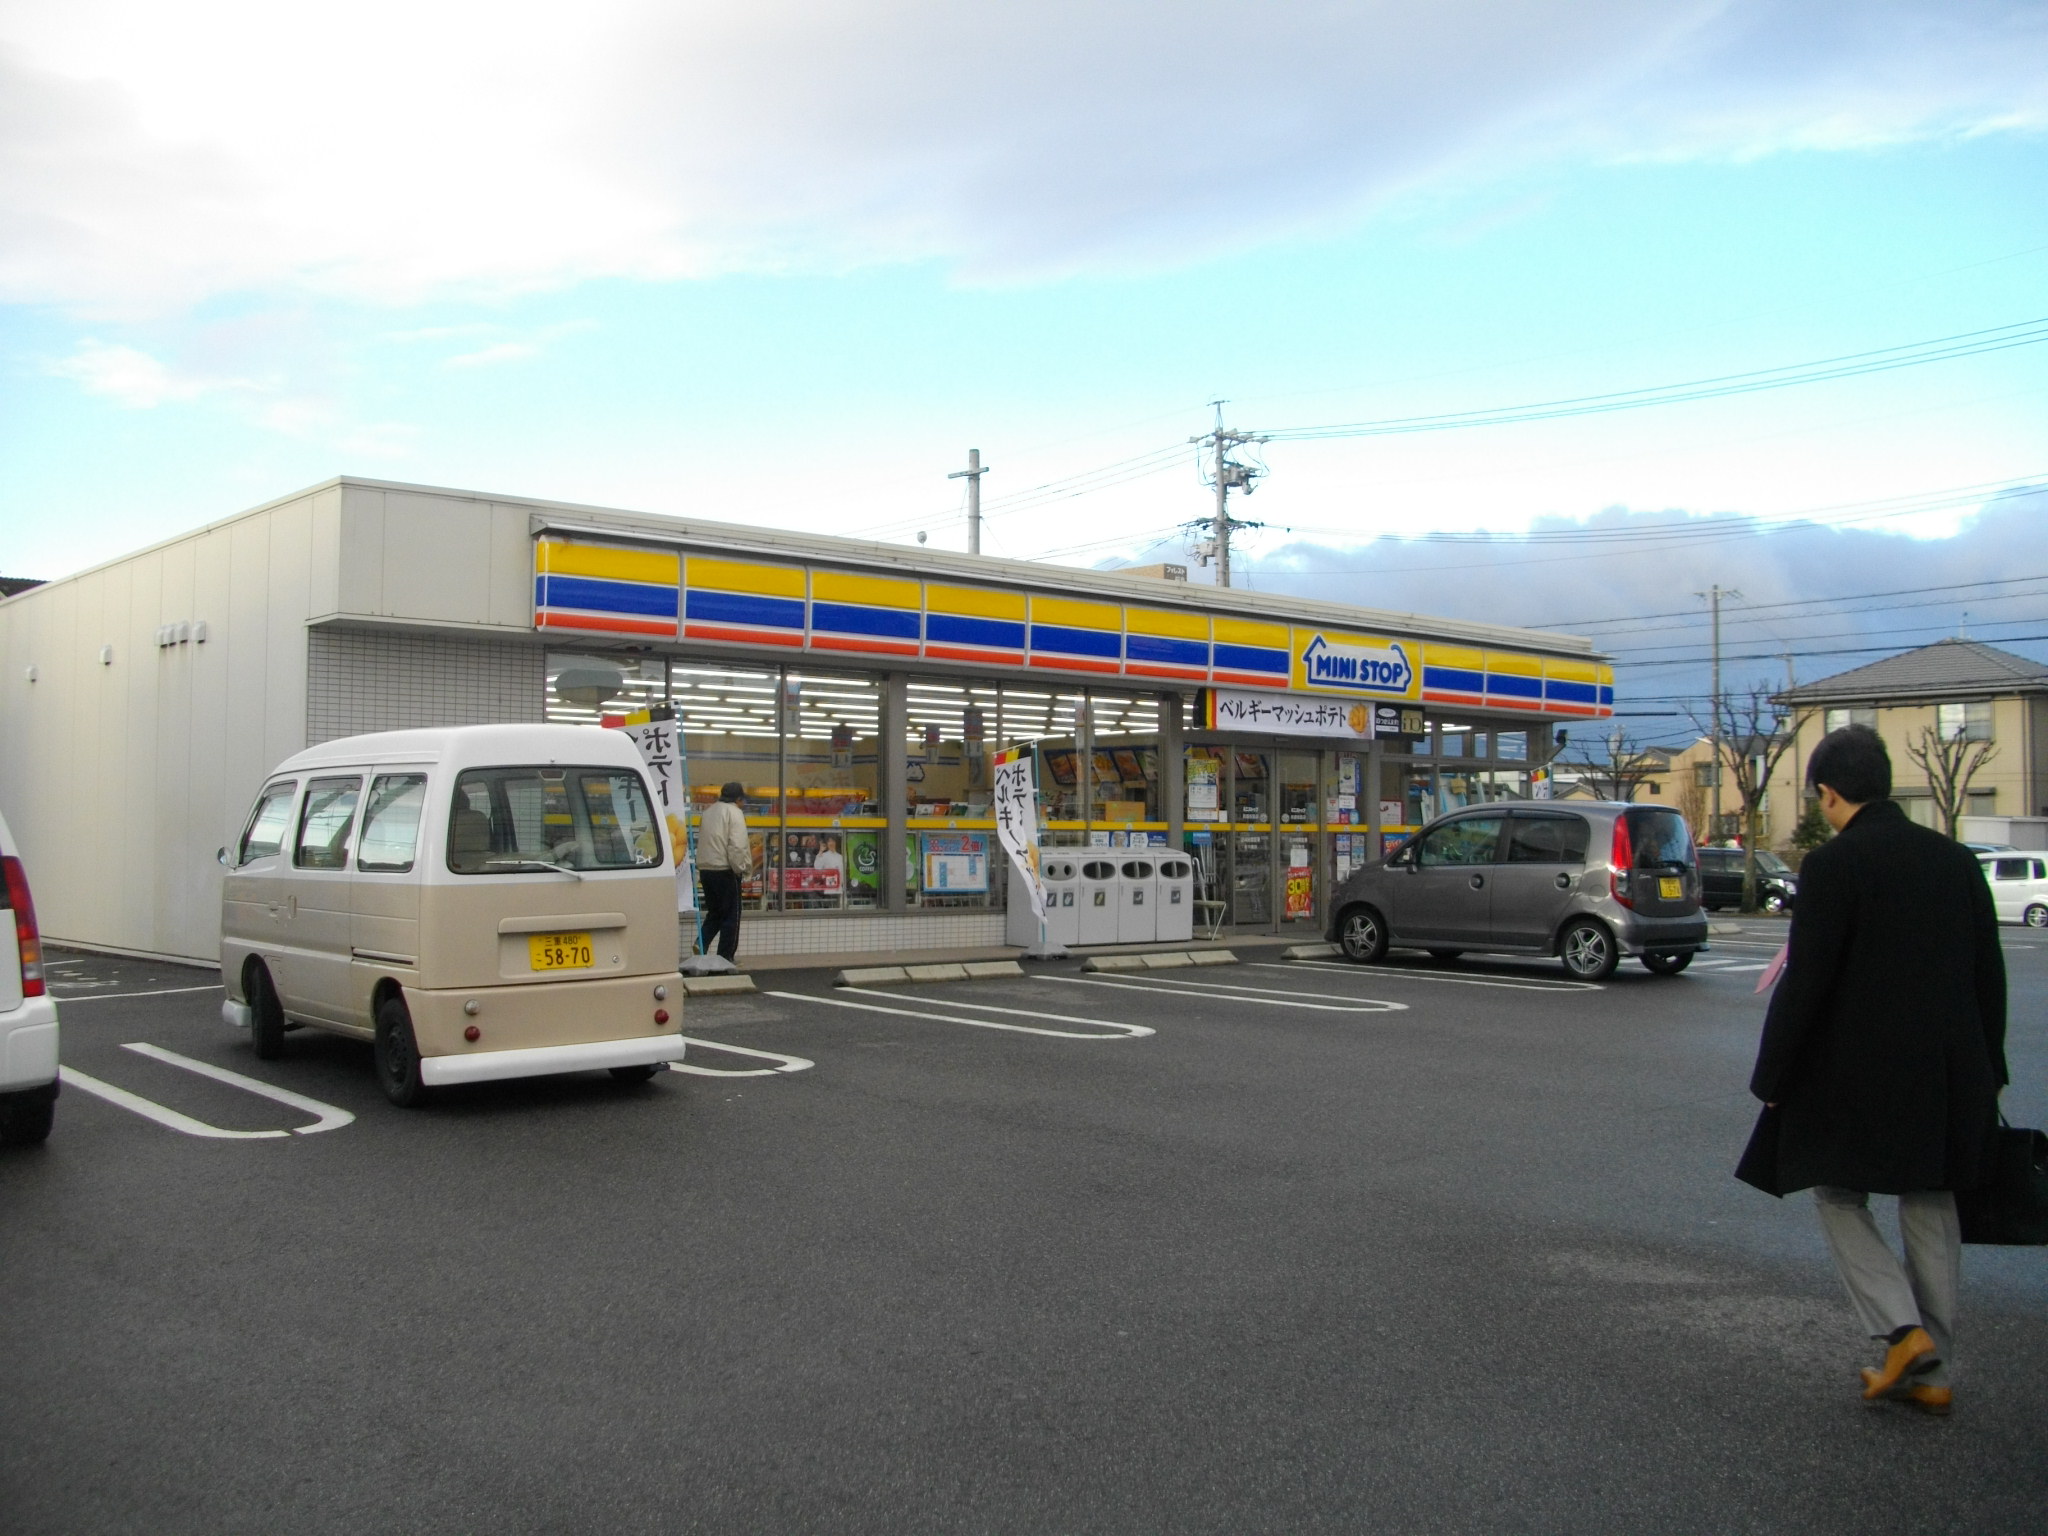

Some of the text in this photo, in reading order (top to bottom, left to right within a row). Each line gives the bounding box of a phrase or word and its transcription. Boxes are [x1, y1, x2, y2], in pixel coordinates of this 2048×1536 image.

[1316, 654, 1404, 684] MINI STOP
[1219, 699, 1347, 728] ベルギーマッシュポテト
[1403, 717, 1422, 732] iD
[545, 936, 578, 947] 三重 480
[544, 947, 590, 966] 58-70
